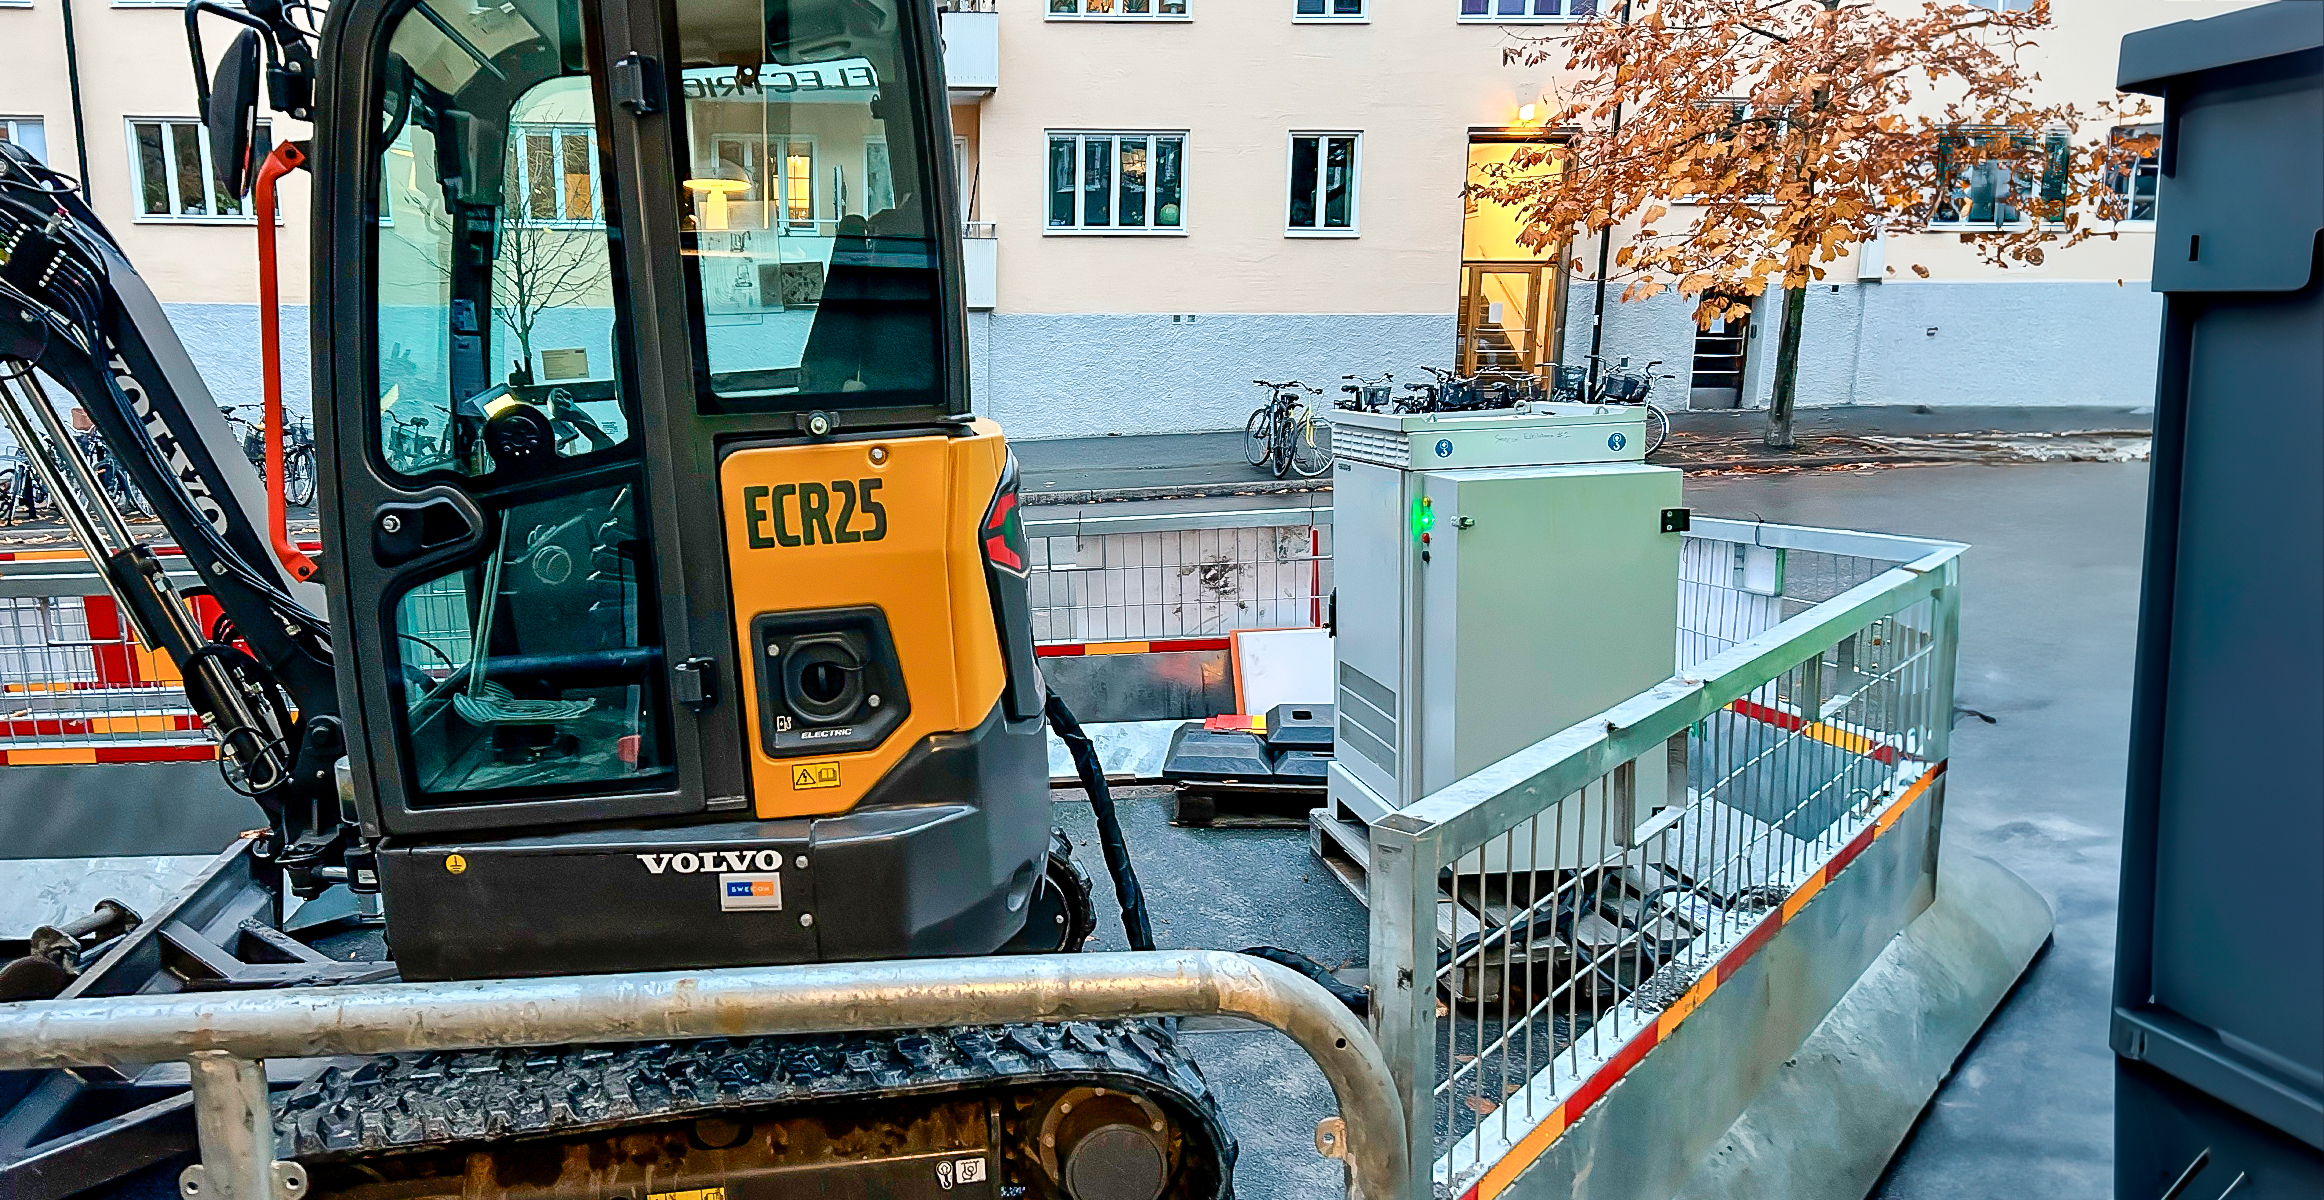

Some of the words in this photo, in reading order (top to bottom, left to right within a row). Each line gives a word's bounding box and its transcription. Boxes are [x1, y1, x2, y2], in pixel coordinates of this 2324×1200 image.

[744, 478, 887, 549] ECR25
[801, 728, 852, 739] ELECTRIC
[636, 850, 783, 874] VOLVO
